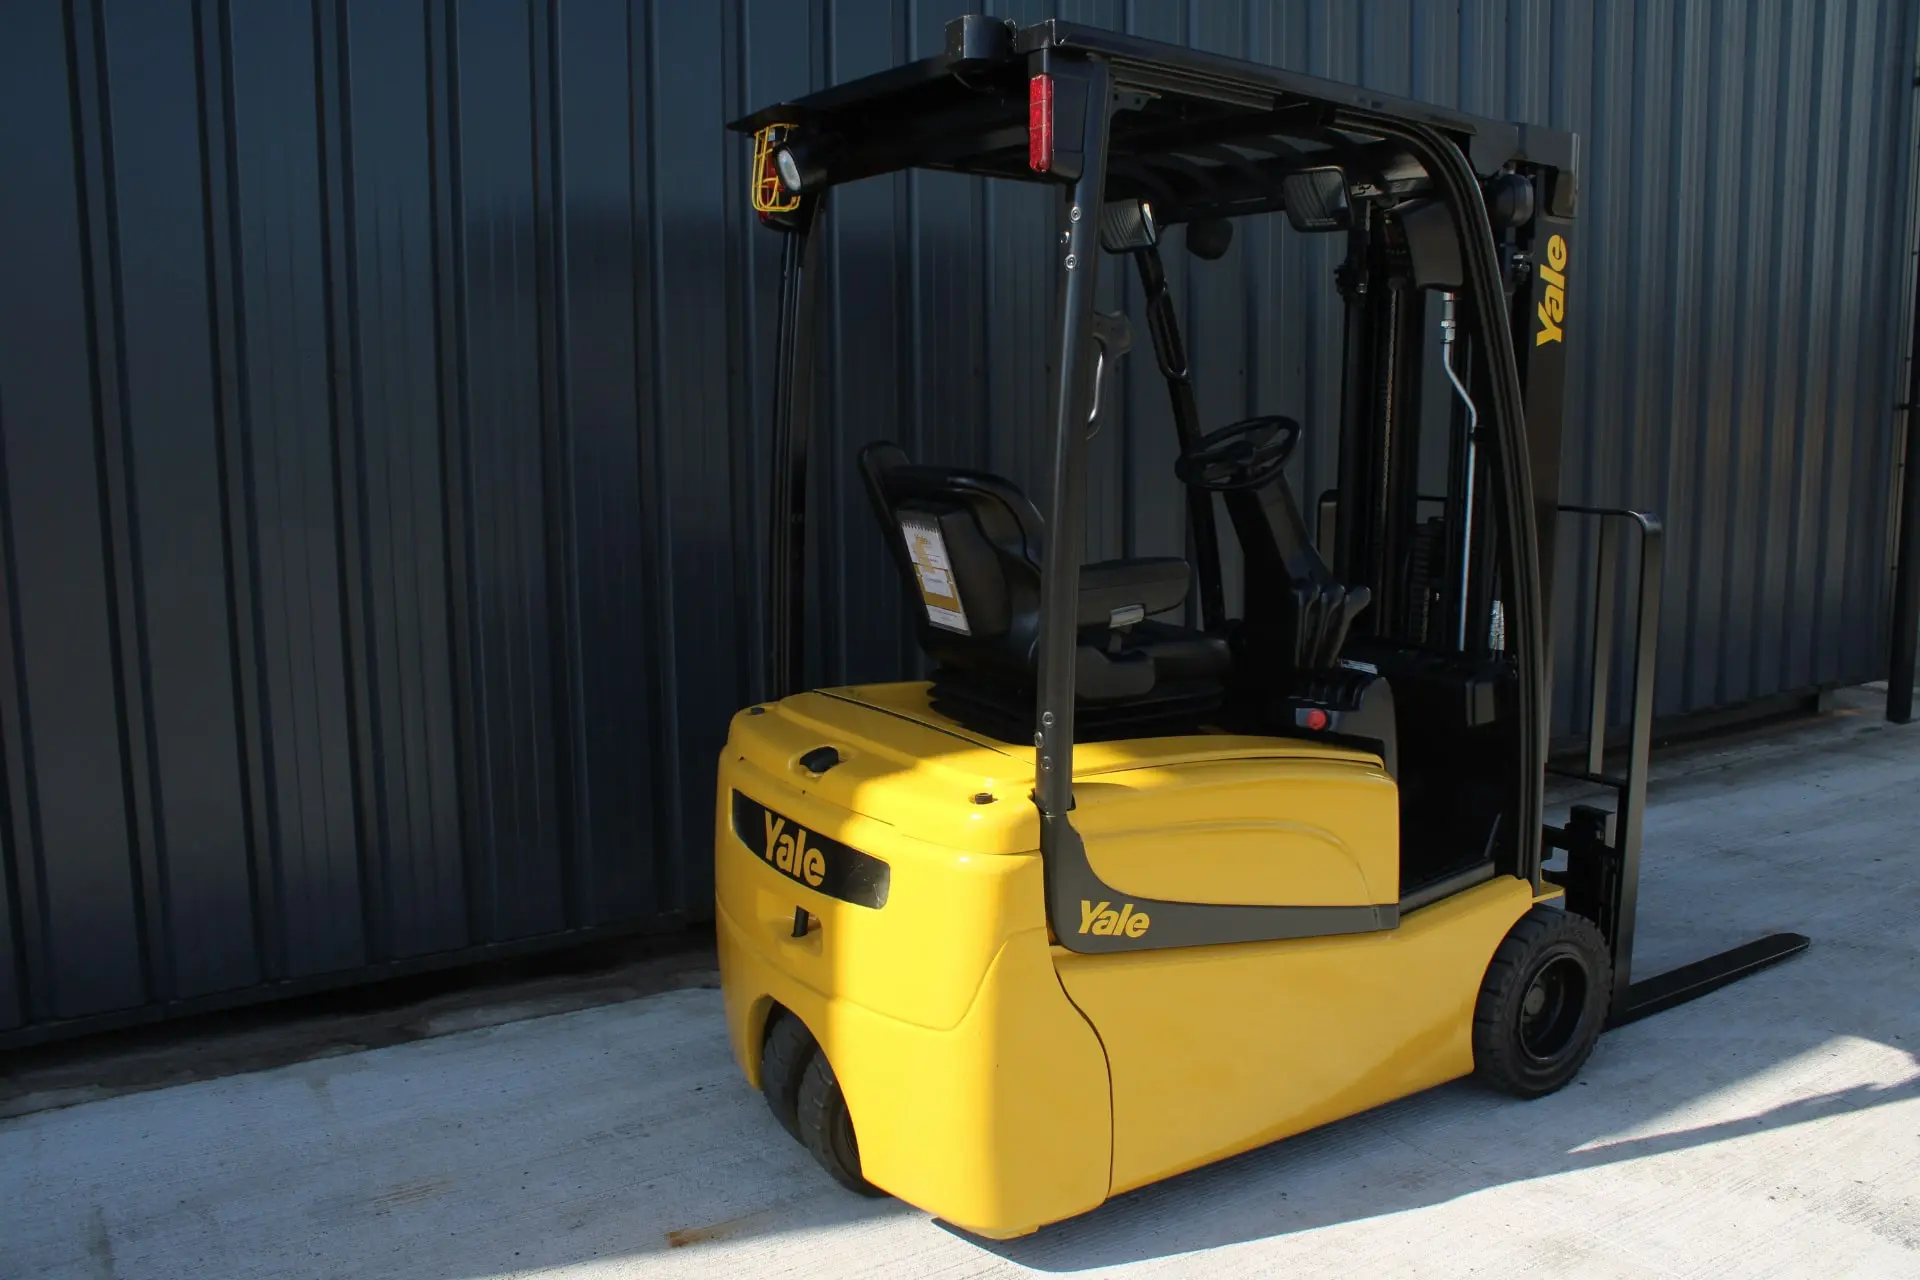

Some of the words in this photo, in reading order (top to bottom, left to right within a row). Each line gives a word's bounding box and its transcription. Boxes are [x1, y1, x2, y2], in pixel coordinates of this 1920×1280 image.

[1536, 234, 1567, 347] Yale
[764, 809, 826, 886] Yale
[1078, 900, 1150, 938] Yale
